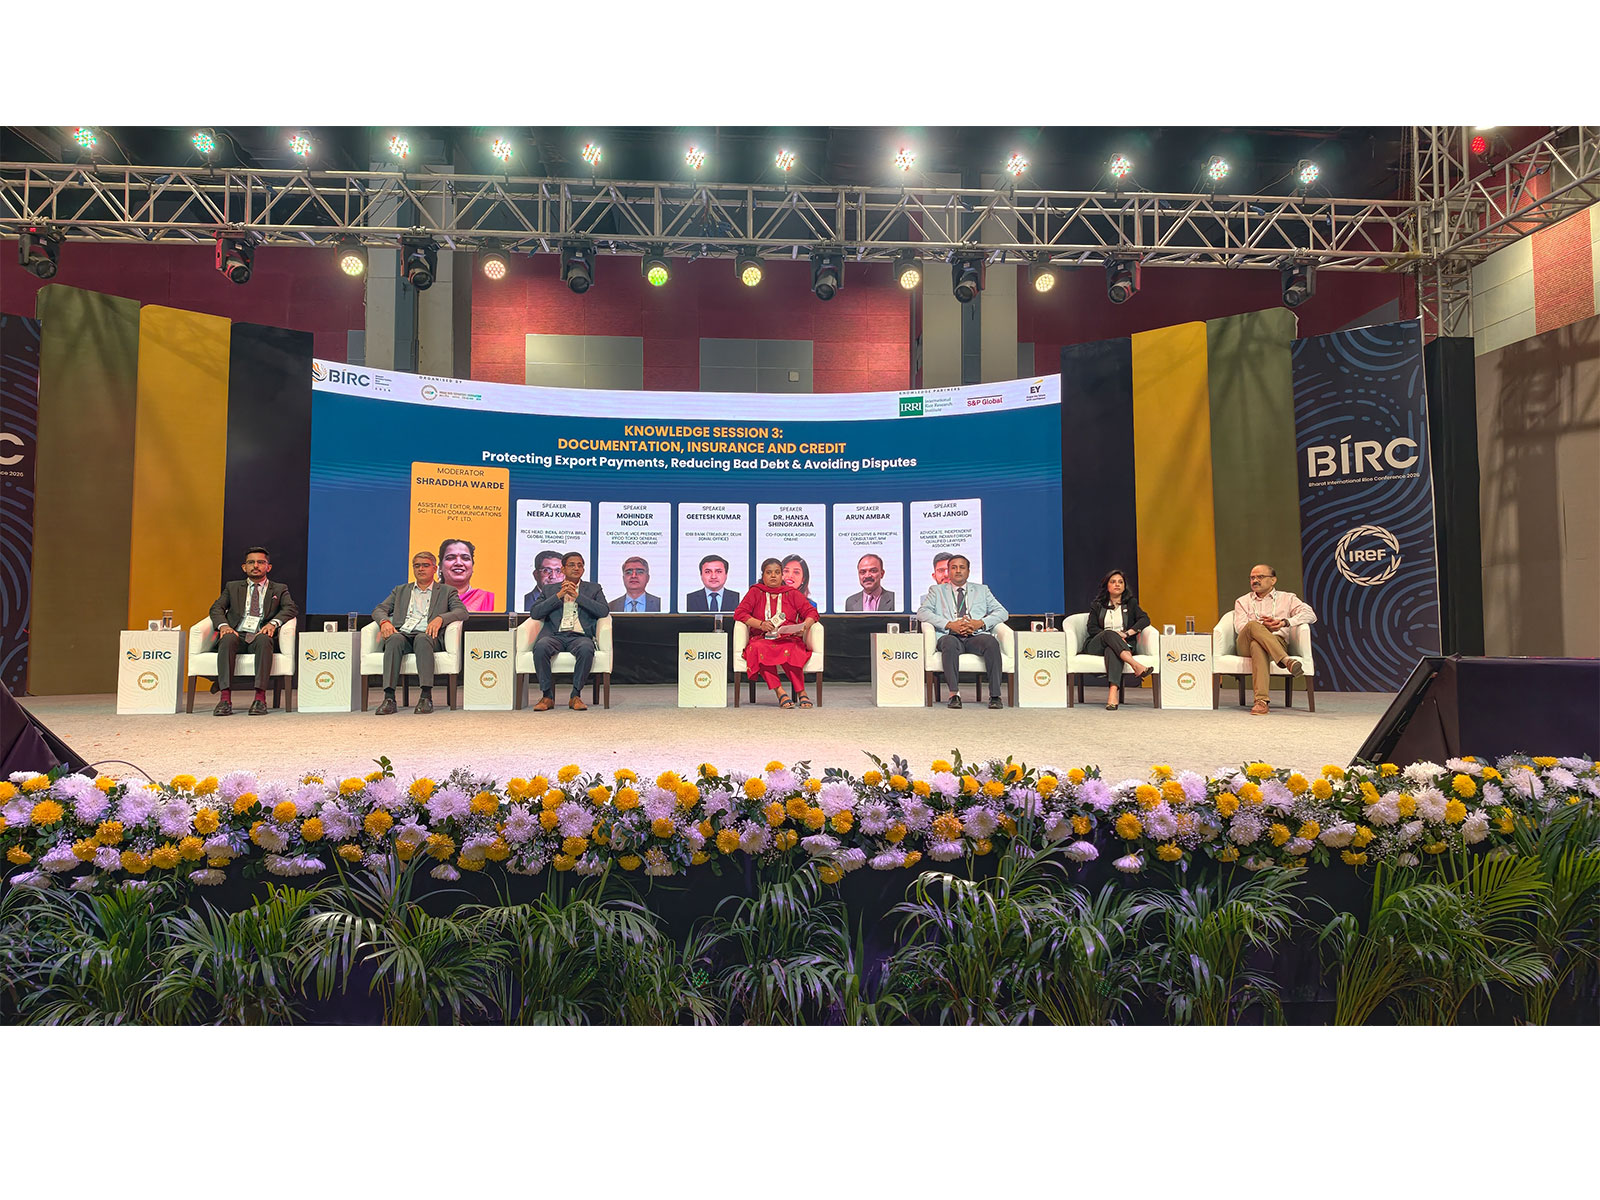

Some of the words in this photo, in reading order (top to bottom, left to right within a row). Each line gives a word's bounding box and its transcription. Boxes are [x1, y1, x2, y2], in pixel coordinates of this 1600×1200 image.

[1030, 386, 1041, 394] EY
[900, 402, 923, 412] IRRI
[625, 425, 710, 438] KNOWLEDGE
[713, 427, 769, 438] SESSION
[771, 427, 783, 439] 3:
[558, 438, 684, 454] DOCUMENTATION,
[687, 441, 764, 453] INSURANCE
[767, 443, 797, 454] AND
[799, 443, 846, 454] CREDIT
[482, 451, 552, 467] Protecting
[555, 455, 597, 469] Export
[599, 457, 668, 471] Payments,
[671, 458, 729, 472] Reducing
[733, 458, 758, 469] Bad
[760, 459, 789, 469] Debt
[792, 459, 801, 469] &
[804, 459, 860, 472] Avoiding
[862, 458, 917, 471] Disputes
[437, 467, 484, 477] MODERATOR
[416, 477, 469, 488] SHRADDHA
[470, 480, 505, 490] WARDE
[1327, 478, 1361, 486] International
[1373, 474, 1406, 482] Conference
[447, 509, 502, 518] COMMUNICATIONS
[942, 510, 969, 518] JANGID
